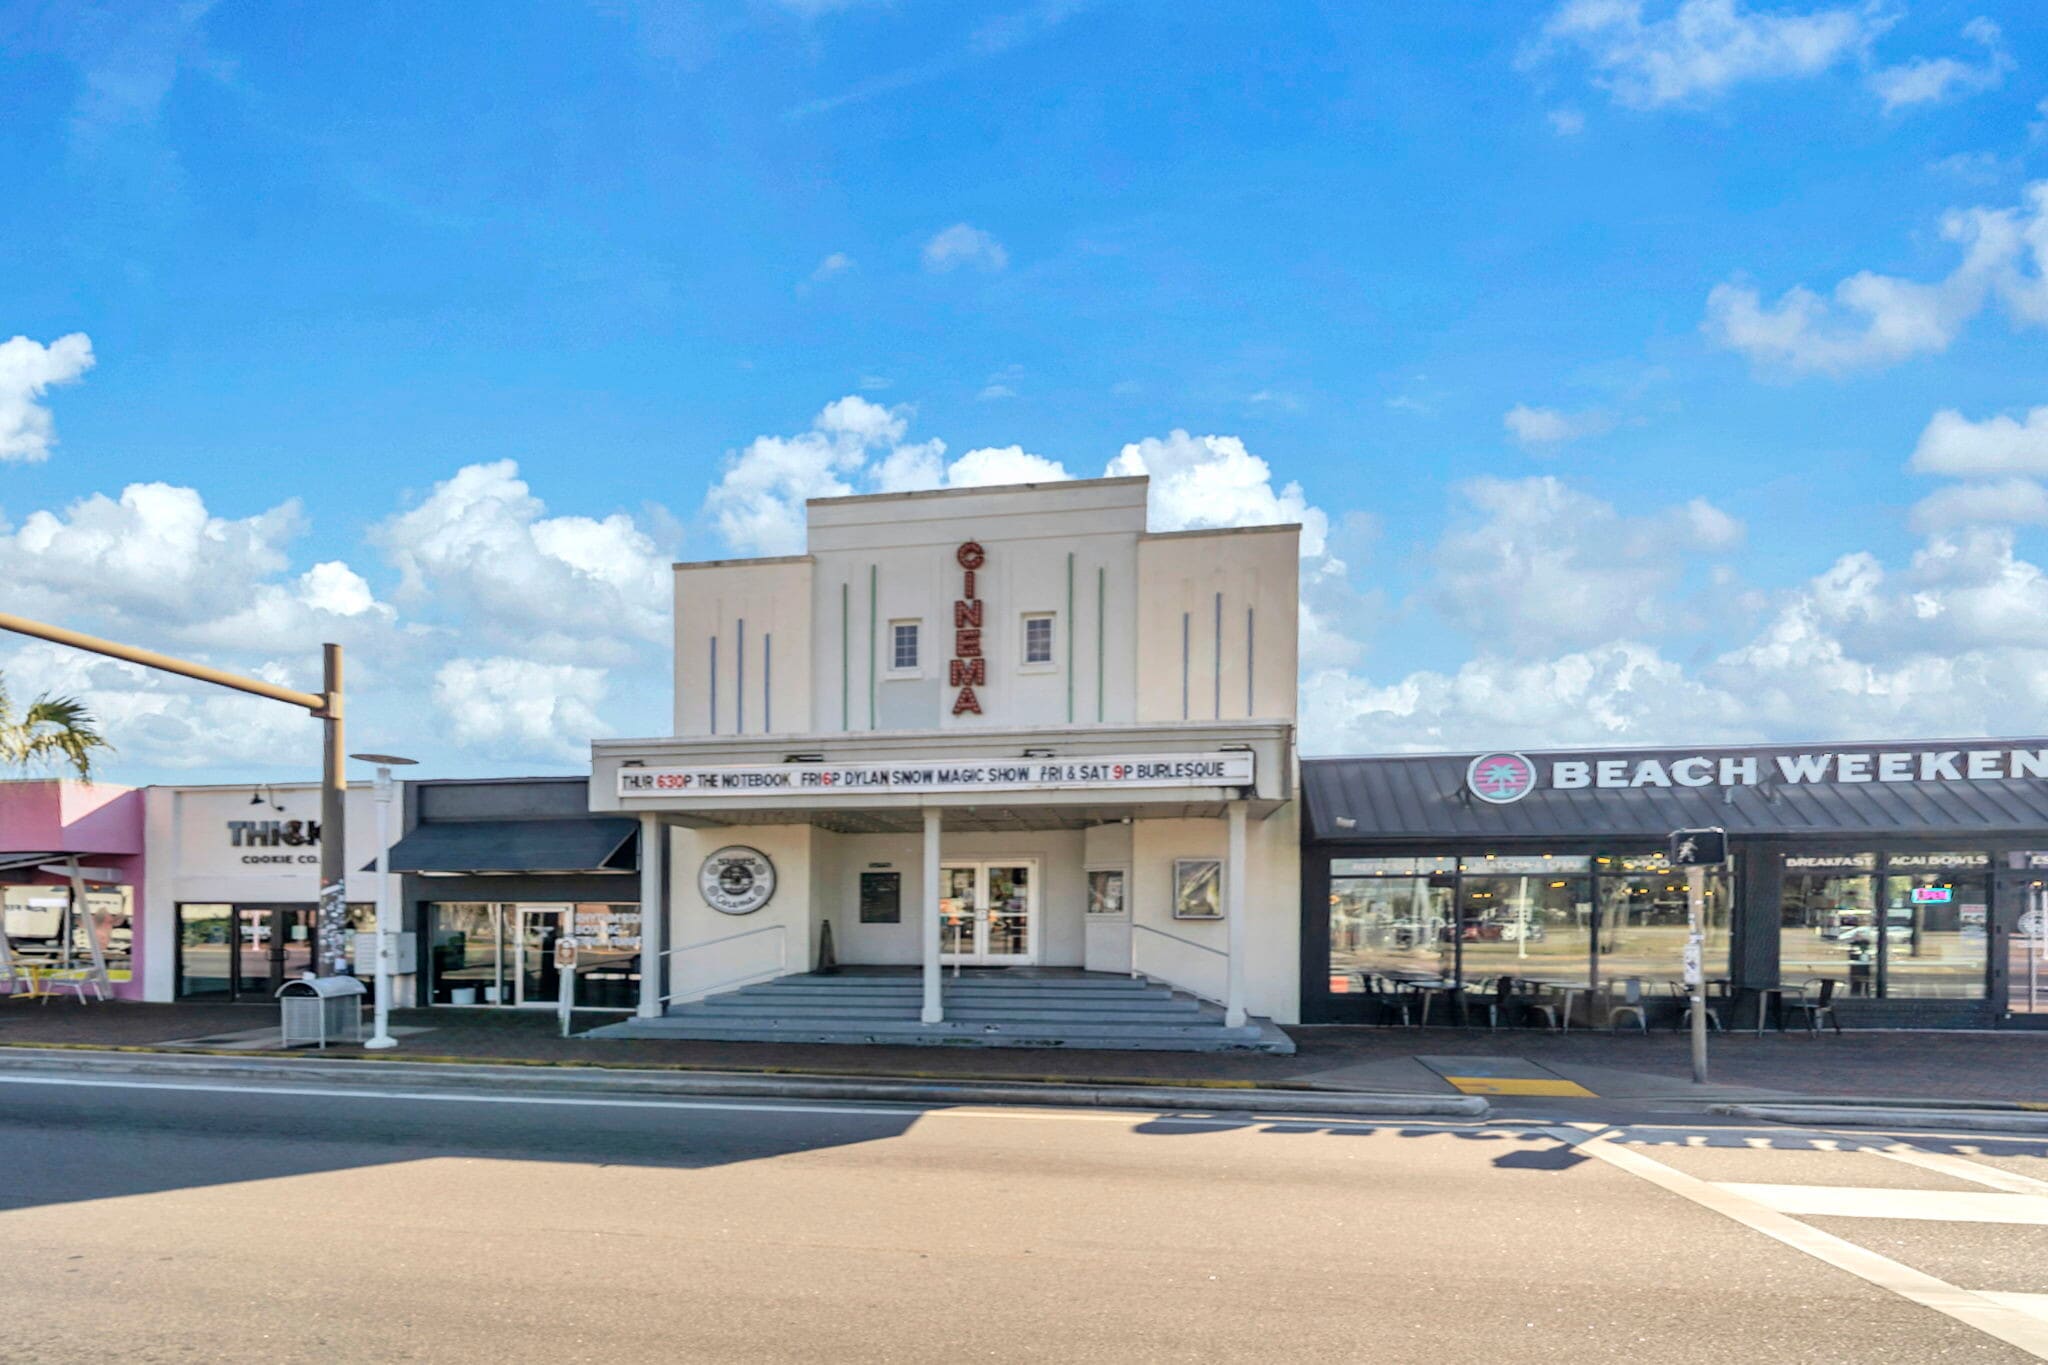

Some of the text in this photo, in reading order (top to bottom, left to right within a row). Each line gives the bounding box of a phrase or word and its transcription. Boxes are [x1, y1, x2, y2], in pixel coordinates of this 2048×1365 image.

[950, 541, 985, 715] CINEMA
[623, 775, 653, 788] THUR
[697, 774, 718, 787] THE
[723, 772, 791, 787] NOTEBOOK
[845, 770, 889, 785] DYLAN
[892, 770, 934, 785] SNOW
[938, 768, 984, 783] MAGIC
[988, 767, 1030, 782] SHOW
[1040, 766, 1063, 781] FRI
[1067, 766, 1076, 780] &
[1080, 765, 1109, 780] SAT
[1112, 764, 1133, 780] 9P
[1137, 762, 1224, 778] BURLESQUE
[1552, 750, 2048, 789] BEACH WEEKEN
[242, 855, 293, 865] COOKIE
[1786, 857, 1873, 867] BREAKFAST
[1889, 855, 1989, 866] ACAI BOWLS
